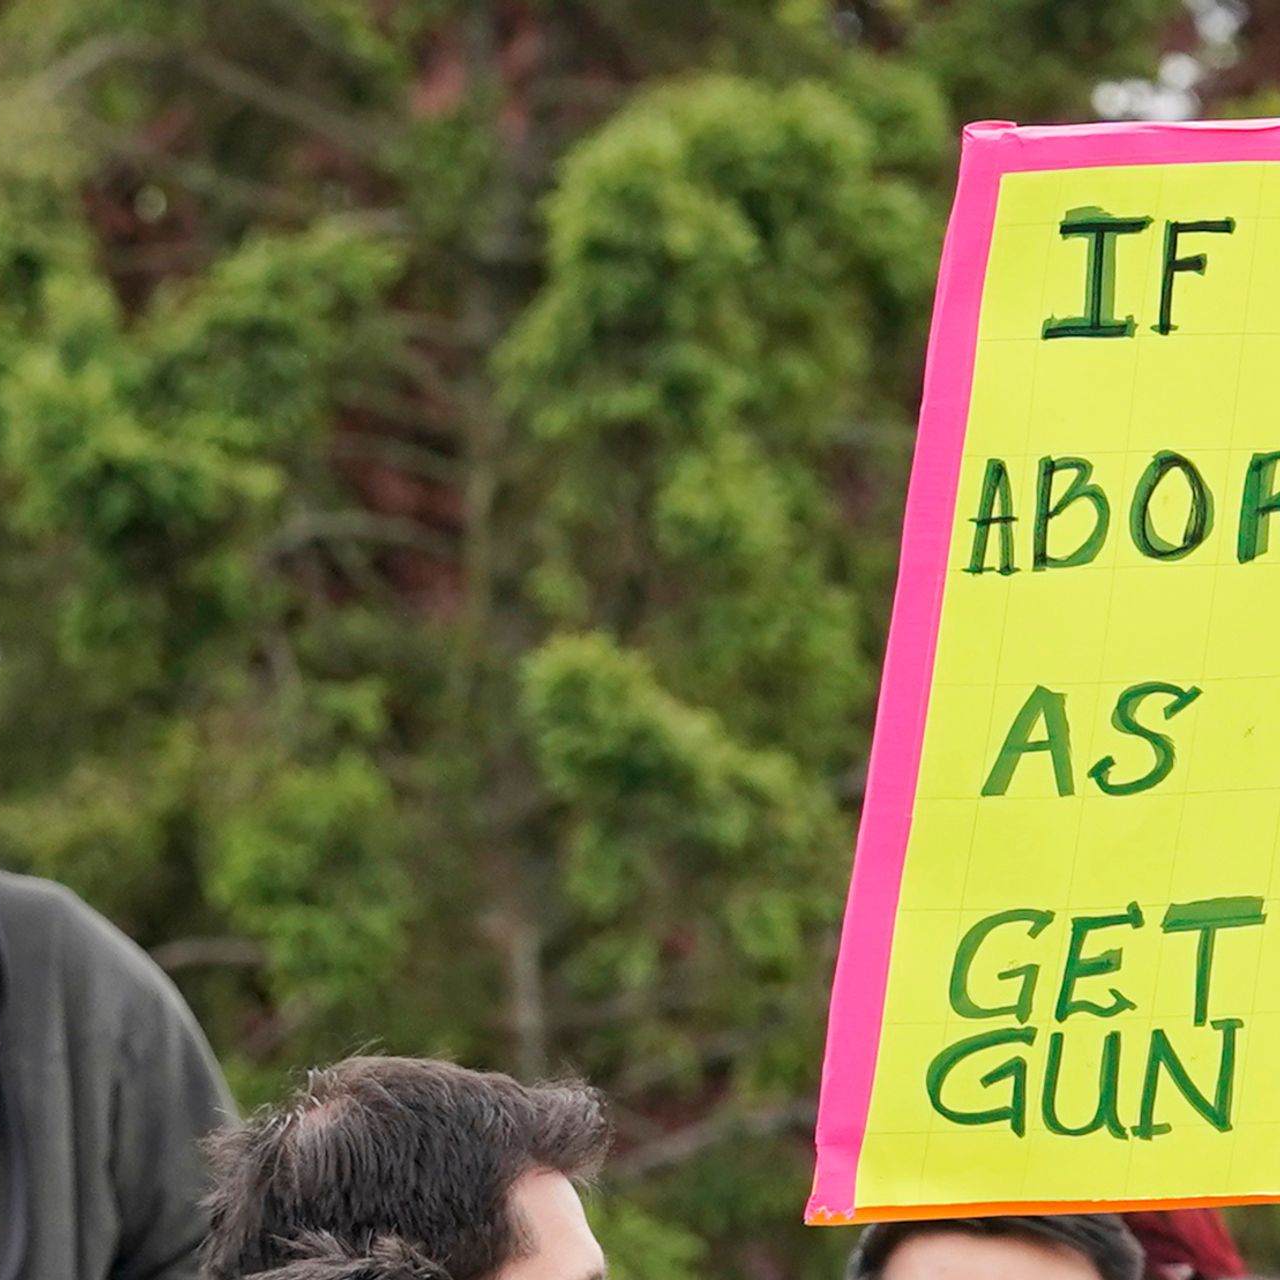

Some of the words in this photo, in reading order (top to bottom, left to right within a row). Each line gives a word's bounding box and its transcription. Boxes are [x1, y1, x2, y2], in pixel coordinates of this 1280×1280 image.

[1041, 207, 1235, 340] IF
[981, 682, 1202, 797] AS
[949, 896, 1266, 1026] GET
[926, 1018, 1243, 1140] GUN
